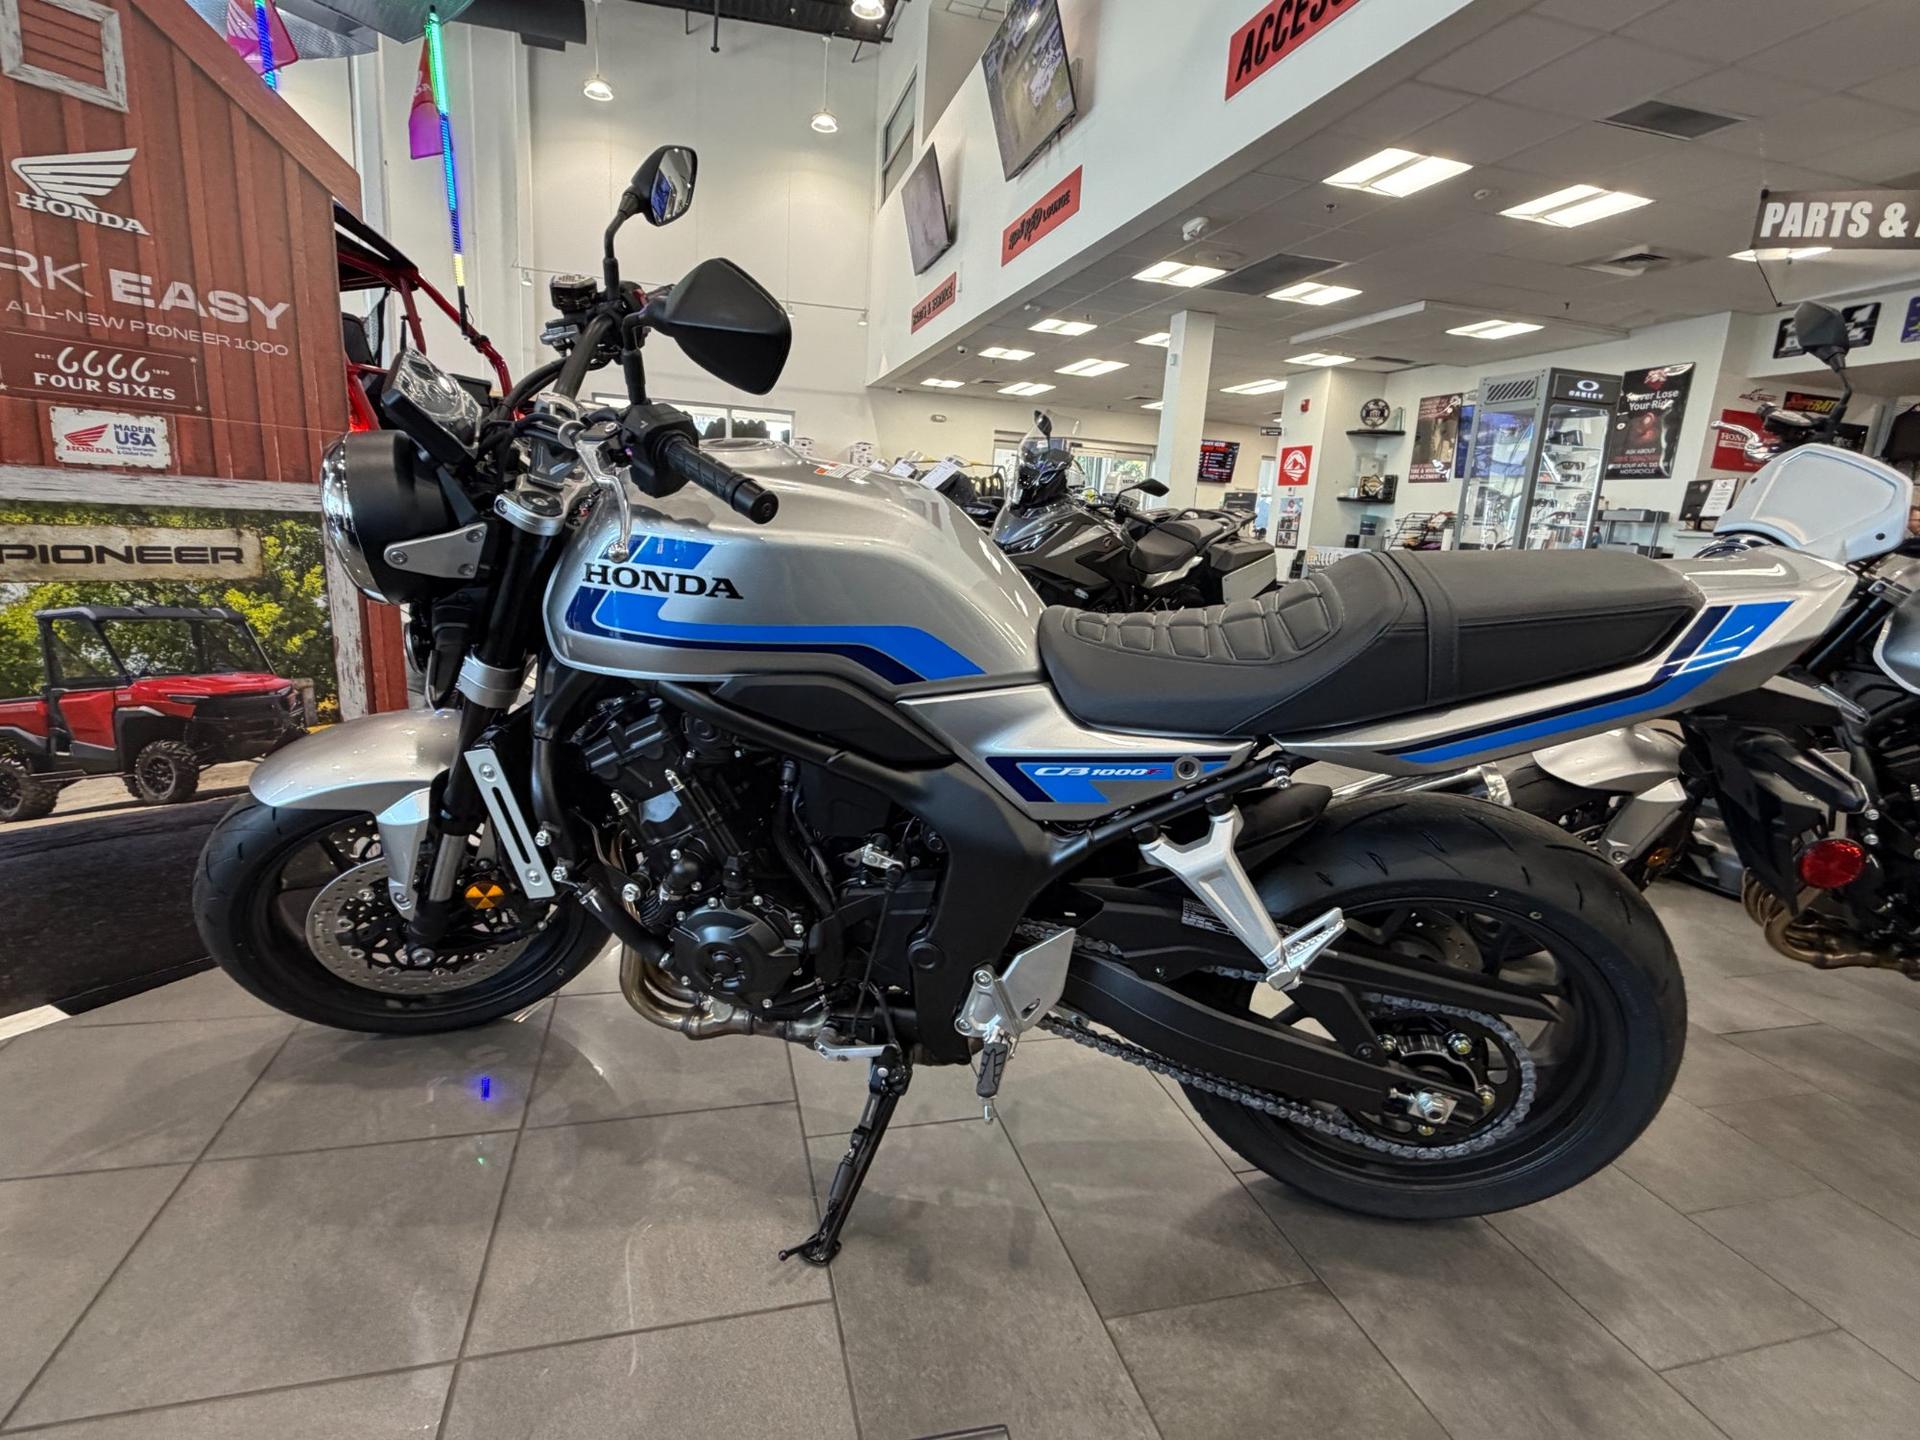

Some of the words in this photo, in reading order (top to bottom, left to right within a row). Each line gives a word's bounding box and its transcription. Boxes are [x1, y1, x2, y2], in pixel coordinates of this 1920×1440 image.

[1235, 0, 1342, 82] ACCE
[15, 191, 151, 236] HONDA
[1760, 201, 1873, 239] PARTS
[1878, 202, 1909, 238] &
[109, 268, 290, 330] EASY
[5, 300, 125, 330] ALL-NEW
[130, 320, 231, 347] PIONEER
[234, 338, 289, 356] 1000
[33, 372, 103, 392] FOUR
[107, 381, 176, 401] SIXES
[1568, 390, 1604, 399] OAKLEY
[1656, 390, 1680, 399] Lose
[1630, 402, 1650, 411] Your
[113, 423, 144, 433] MADE
[1721, 432, 1746, 441] HON
[114, 431, 157, 447] USA
[65, 445, 114, 454] HONDA
[0, 544, 244, 564] PIONEER
[582, 562, 745, 600] HONDA
[1034, 767, 1090, 776] CB
